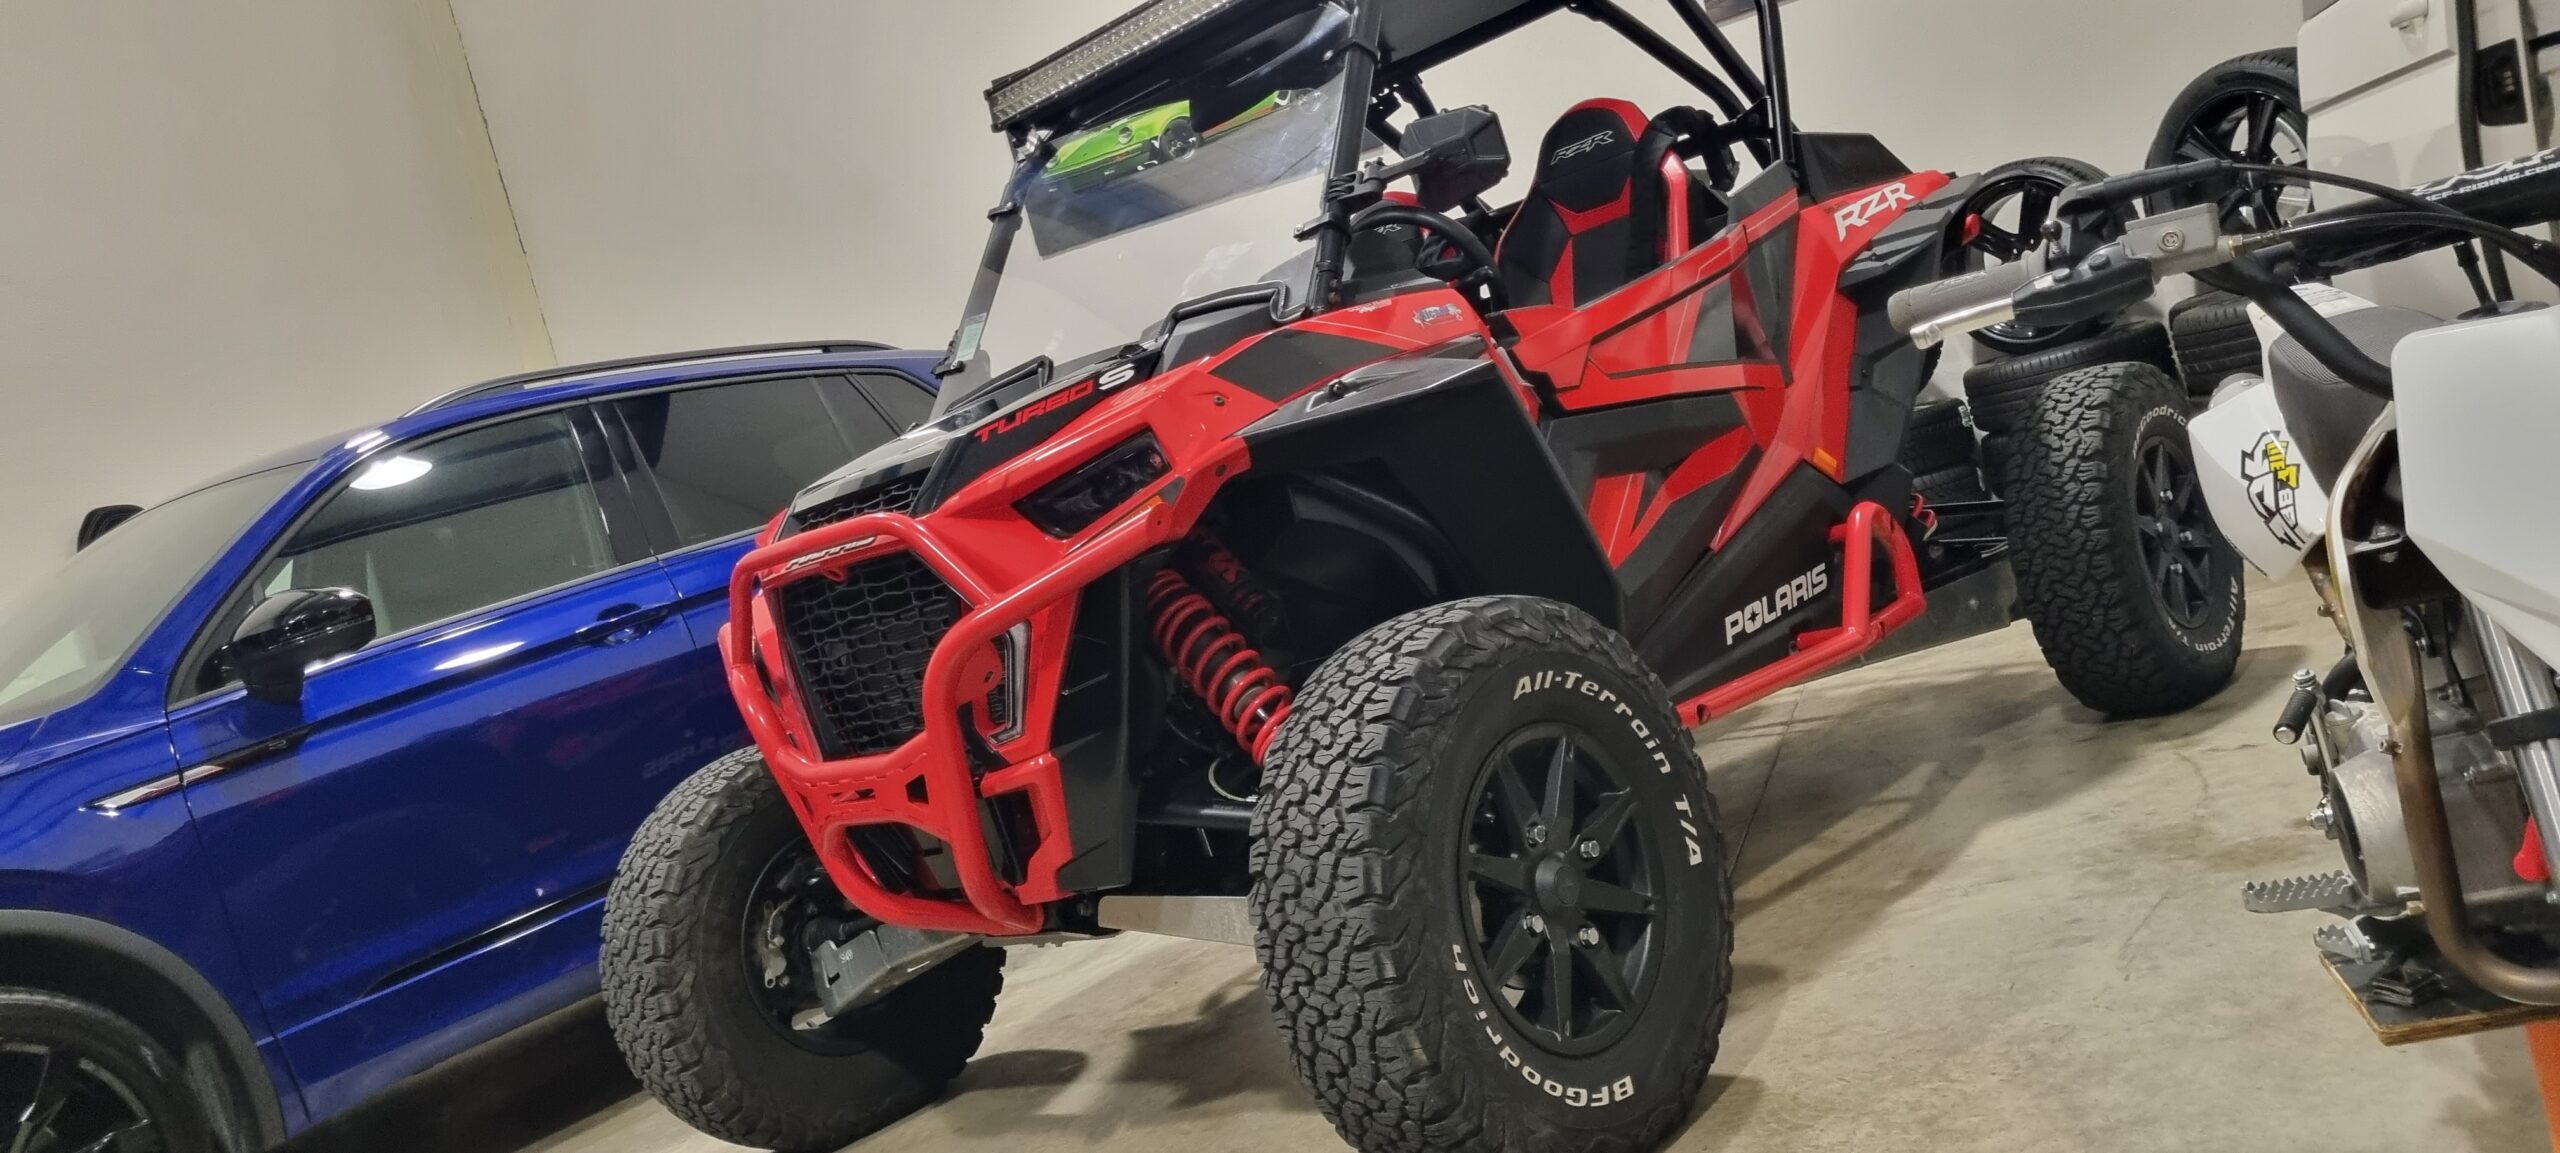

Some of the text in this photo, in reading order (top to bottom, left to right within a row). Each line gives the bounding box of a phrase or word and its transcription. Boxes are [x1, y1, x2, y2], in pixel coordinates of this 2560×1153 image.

[1550, 130, 1615, 166] RZR
[1834, 182, 1915, 243] RZR
[975, 363, 1135, 443] TURBO S
[1724, 562, 1828, 646] POLARIS
[1513, 670, 1703, 866] All-Terrain T/A
[1452, 944, 1635, 1107] BFGoodrich
